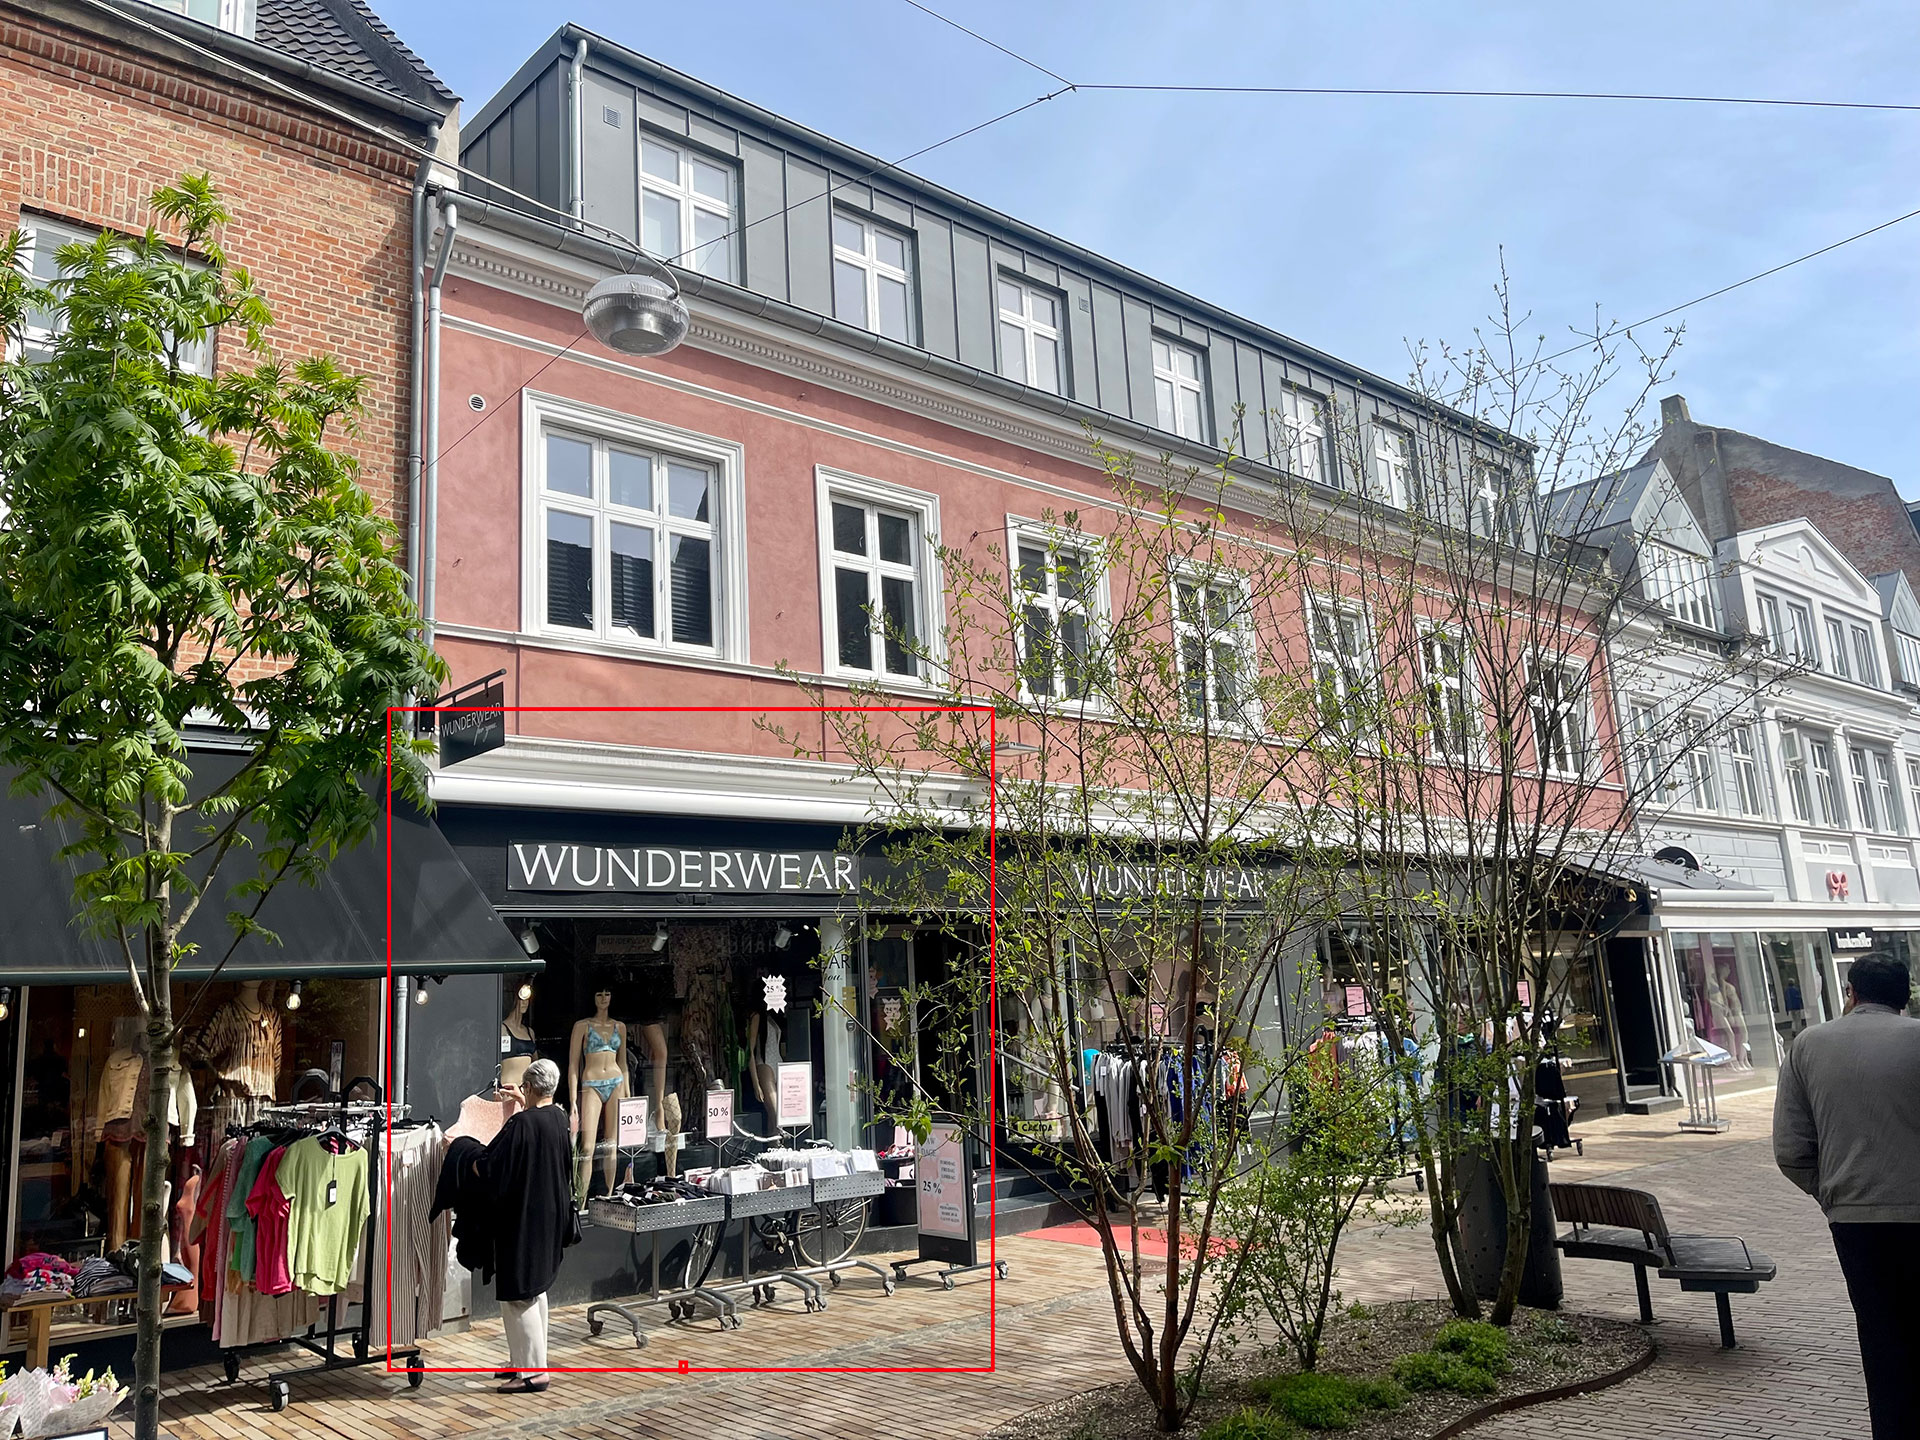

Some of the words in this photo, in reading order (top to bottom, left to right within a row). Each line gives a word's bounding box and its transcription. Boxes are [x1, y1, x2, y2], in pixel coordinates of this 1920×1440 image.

[441, 702, 501, 738] WUNDERWEAR
[514, 843, 856, 890] WUNDERWEAR
[708, 1107, 719, 1117] 50
[720, 1106, 729, 1116] %
[621, 1115, 633, 1125] 50
[635, 1114, 643, 1124] %
[923, 1180, 932, 1192] 25
[933, 1182, 941, 1194] %
